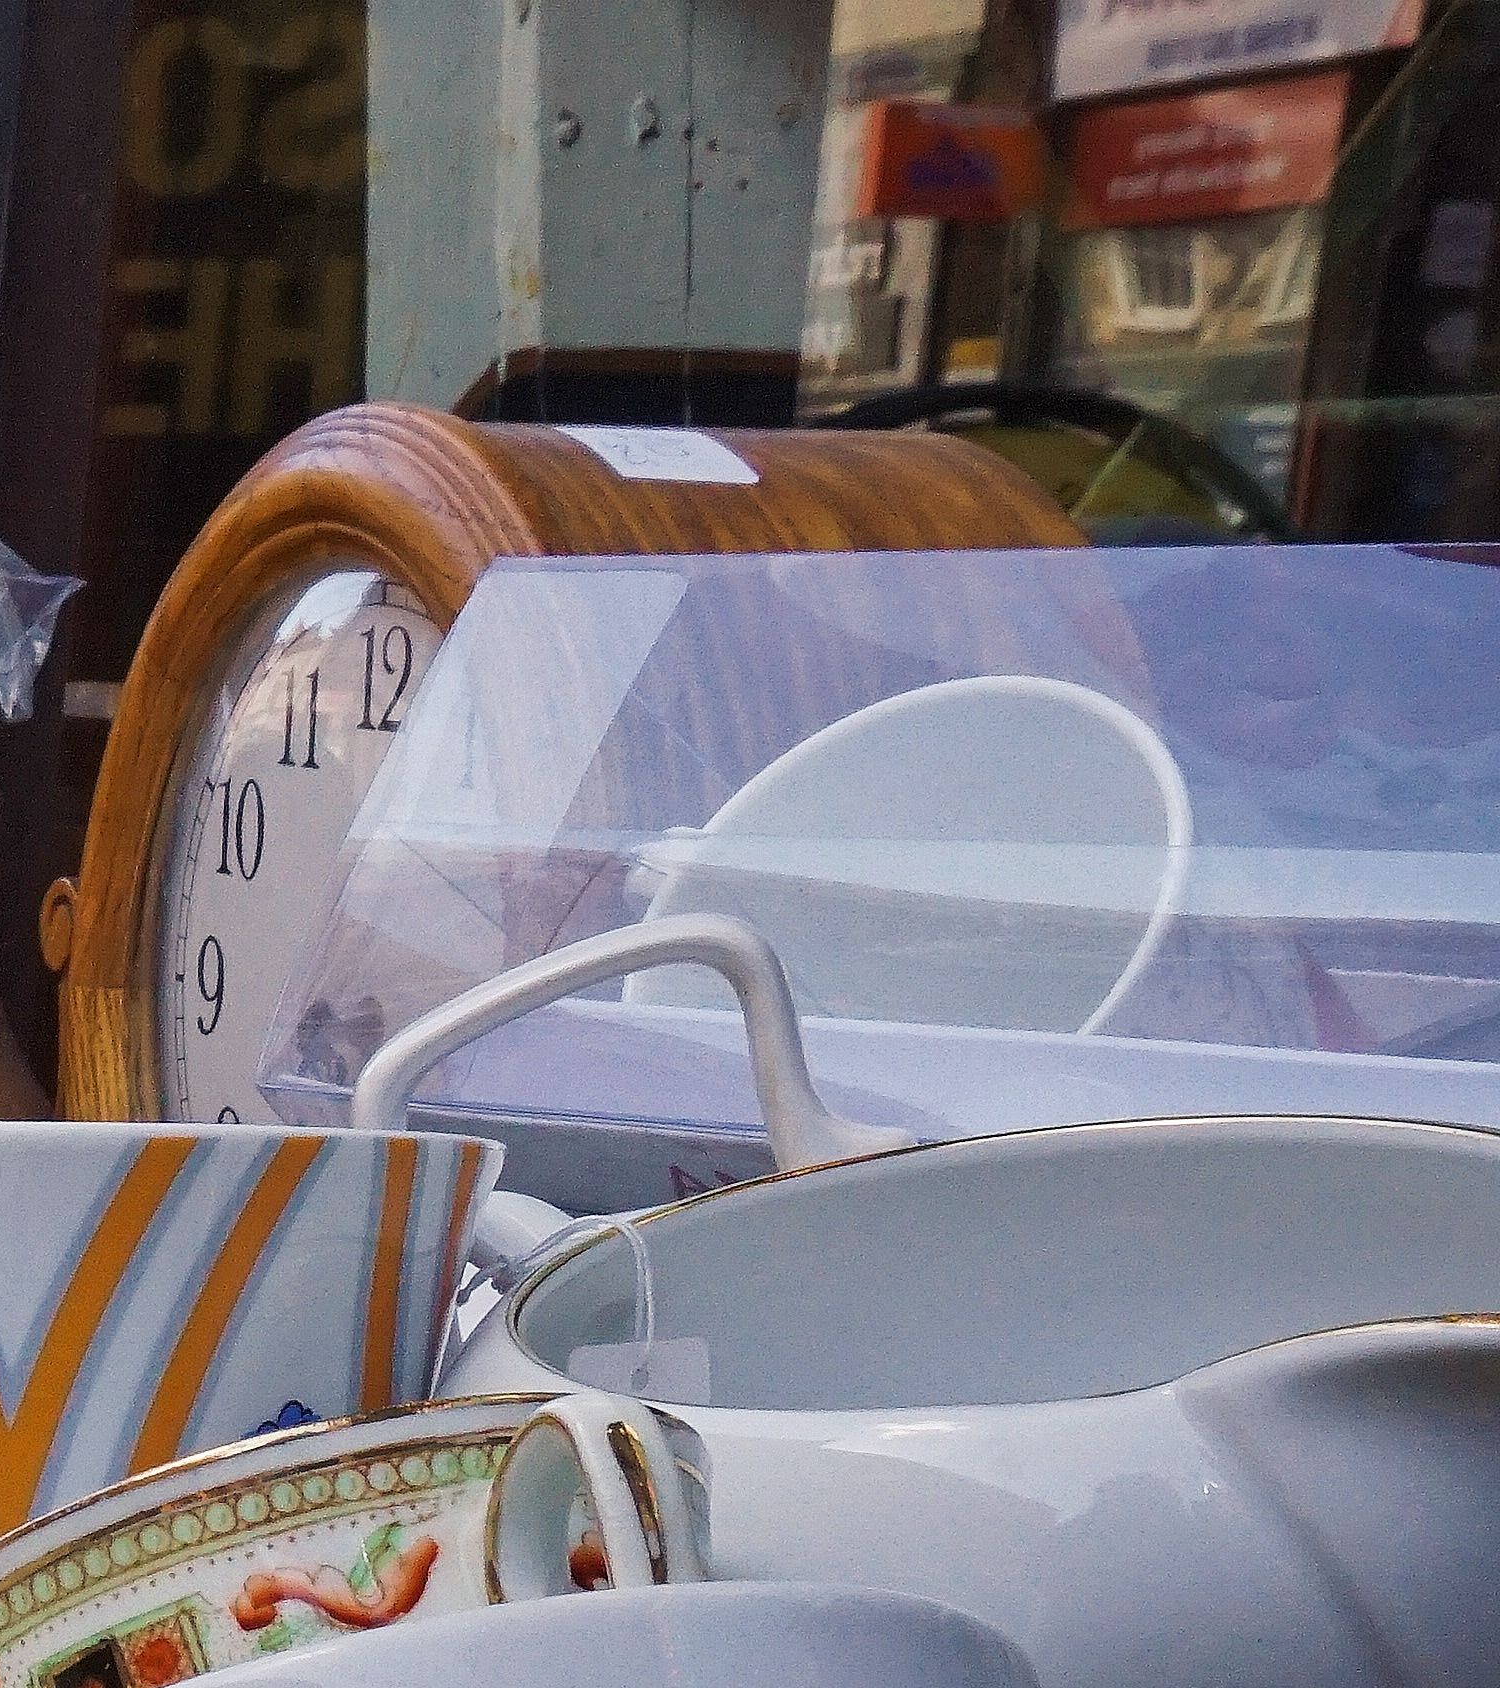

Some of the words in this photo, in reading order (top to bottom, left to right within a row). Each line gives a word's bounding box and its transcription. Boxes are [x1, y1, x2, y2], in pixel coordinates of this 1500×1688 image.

[276, 665, 322, 770] 11
[356, 624, 414, 733] 12
[214, 776, 266, 881] 10
[196, 933, 226, 1036] 9
